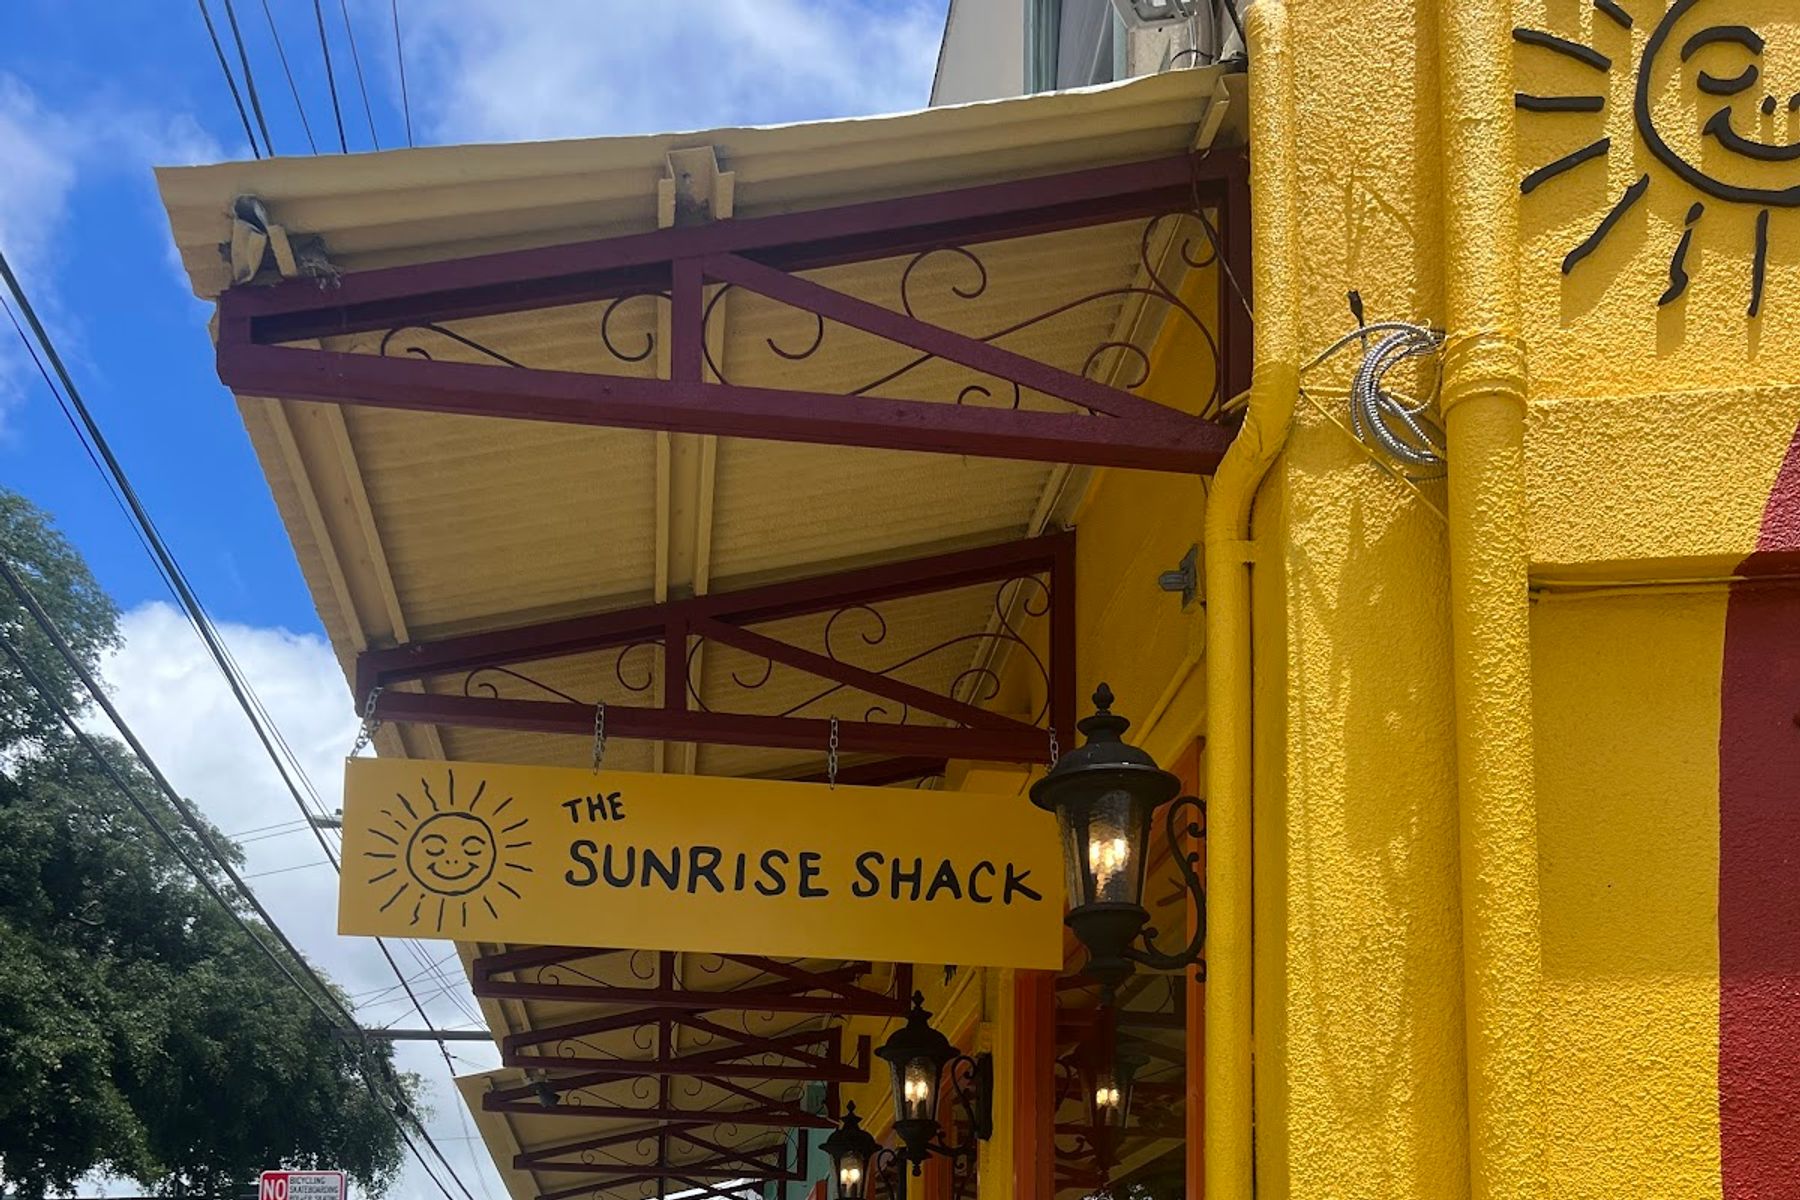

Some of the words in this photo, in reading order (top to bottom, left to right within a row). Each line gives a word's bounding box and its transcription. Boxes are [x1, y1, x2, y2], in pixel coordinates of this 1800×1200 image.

[562, 791, 626, 824] THE
[565, 839, 829, 898] SUNRISE
[852, 851, 1042, 904] SHACK
[262, 1178, 287, 1200] NO
[289, 1176, 326, 1185] BICYCLING
[289, 1185, 339, 1194] SKATEBOARDING
